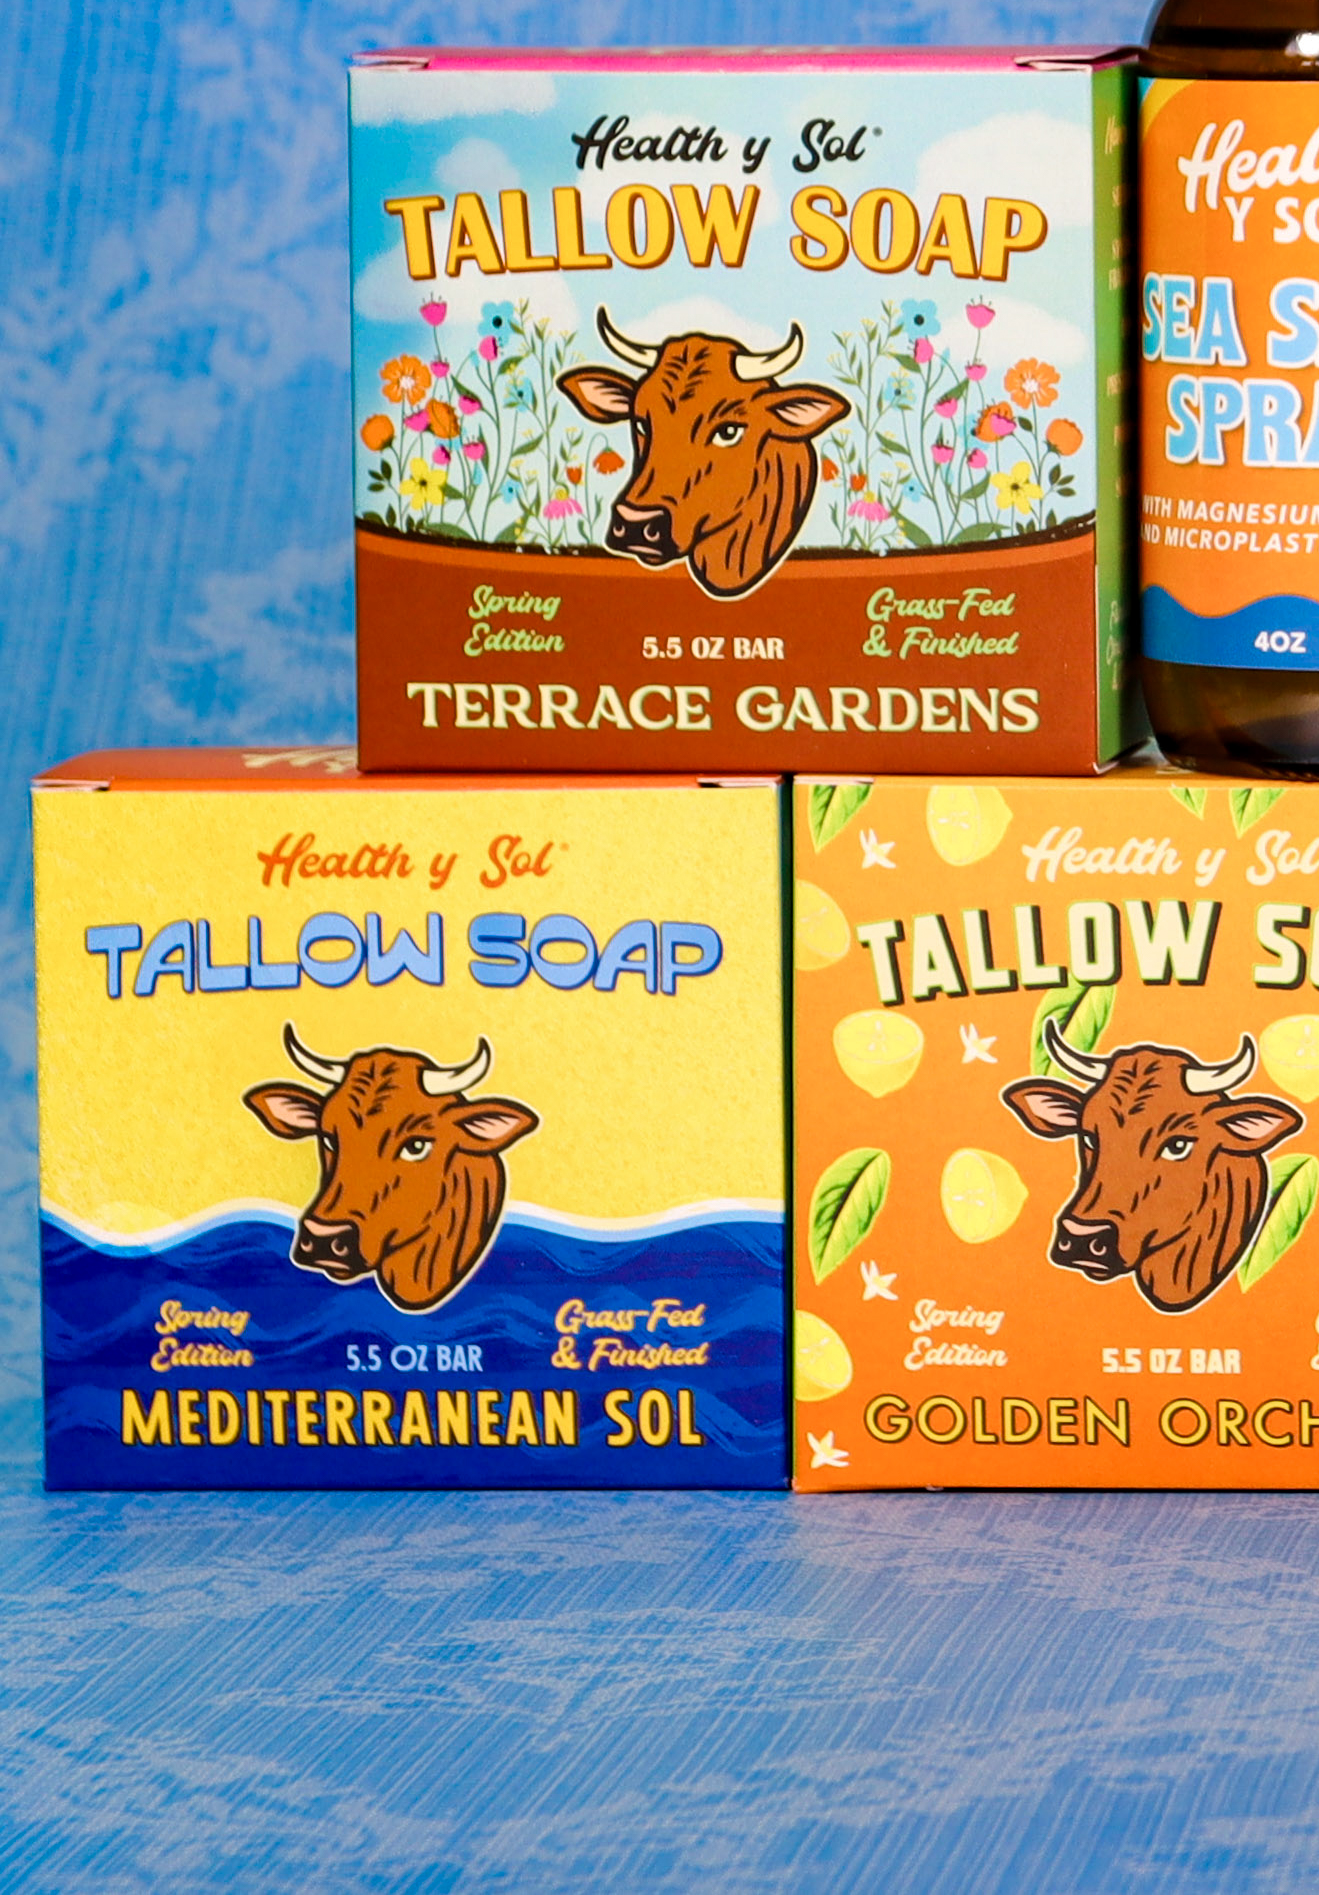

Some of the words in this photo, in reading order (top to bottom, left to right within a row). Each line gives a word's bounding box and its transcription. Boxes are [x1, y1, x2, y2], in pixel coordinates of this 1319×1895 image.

[571, 114, 728, 171] Health
[742, 134, 771, 173] y
[384, 184, 760, 280] TALLOW
[790, 186, 1047, 282] SOAP
[1223, 197, 1253, 243] Y
[1142, 272, 1247, 367] SEA
[468, 585, 561, 620] Spring
[866, 587, 1015, 621] Grass-Fed
[463, 622, 564, 656] Edition
[642, 637, 684, 659] 5.5
[691, 637, 725, 660] OZ
[733, 636, 785, 660] BAR
[863, 627, 892, 657] &
[900, 626, 1018, 659] Finished
[407, 681, 712, 730] TERRACE
[736, 686, 1039, 733] GARDENS
[258, 833, 413, 888] Health
[430, 850, 459, 889] y
[1021, 826, 1181, 882] Health
[1196, 845, 1226, 886] y
[85, 912, 444, 998] TALLOW
[469, 914, 723, 995] SOAP
[856, 898, 1221, 1007] TALLOW
[155, 1301, 250, 1336] Spring
[556, 1299, 706, 1331] Grass-Fed
[910, 1300, 1004, 1335] Spring
[150, 1340, 254, 1372] Edition
[347, 1345, 383, 1371] 5.5
[390, 1346, 430, 1372] OZ
[436, 1345, 483, 1373] BAR
[551, 1338, 581, 1369] &
[588, 1338, 709, 1371] Finished
[904, 1337, 1008, 1371] Edition
[1102, 1348, 1142, 1374] 5.5
[1149, 1348, 1184, 1374] OZ
[1190, 1348, 1241, 1375] BAR
[120, 1389, 578, 1447] MEDITERRANEAN
[605, 1390, 704, 1447] SOL
[864, 1395, 1131, 1445] GOLDEN
